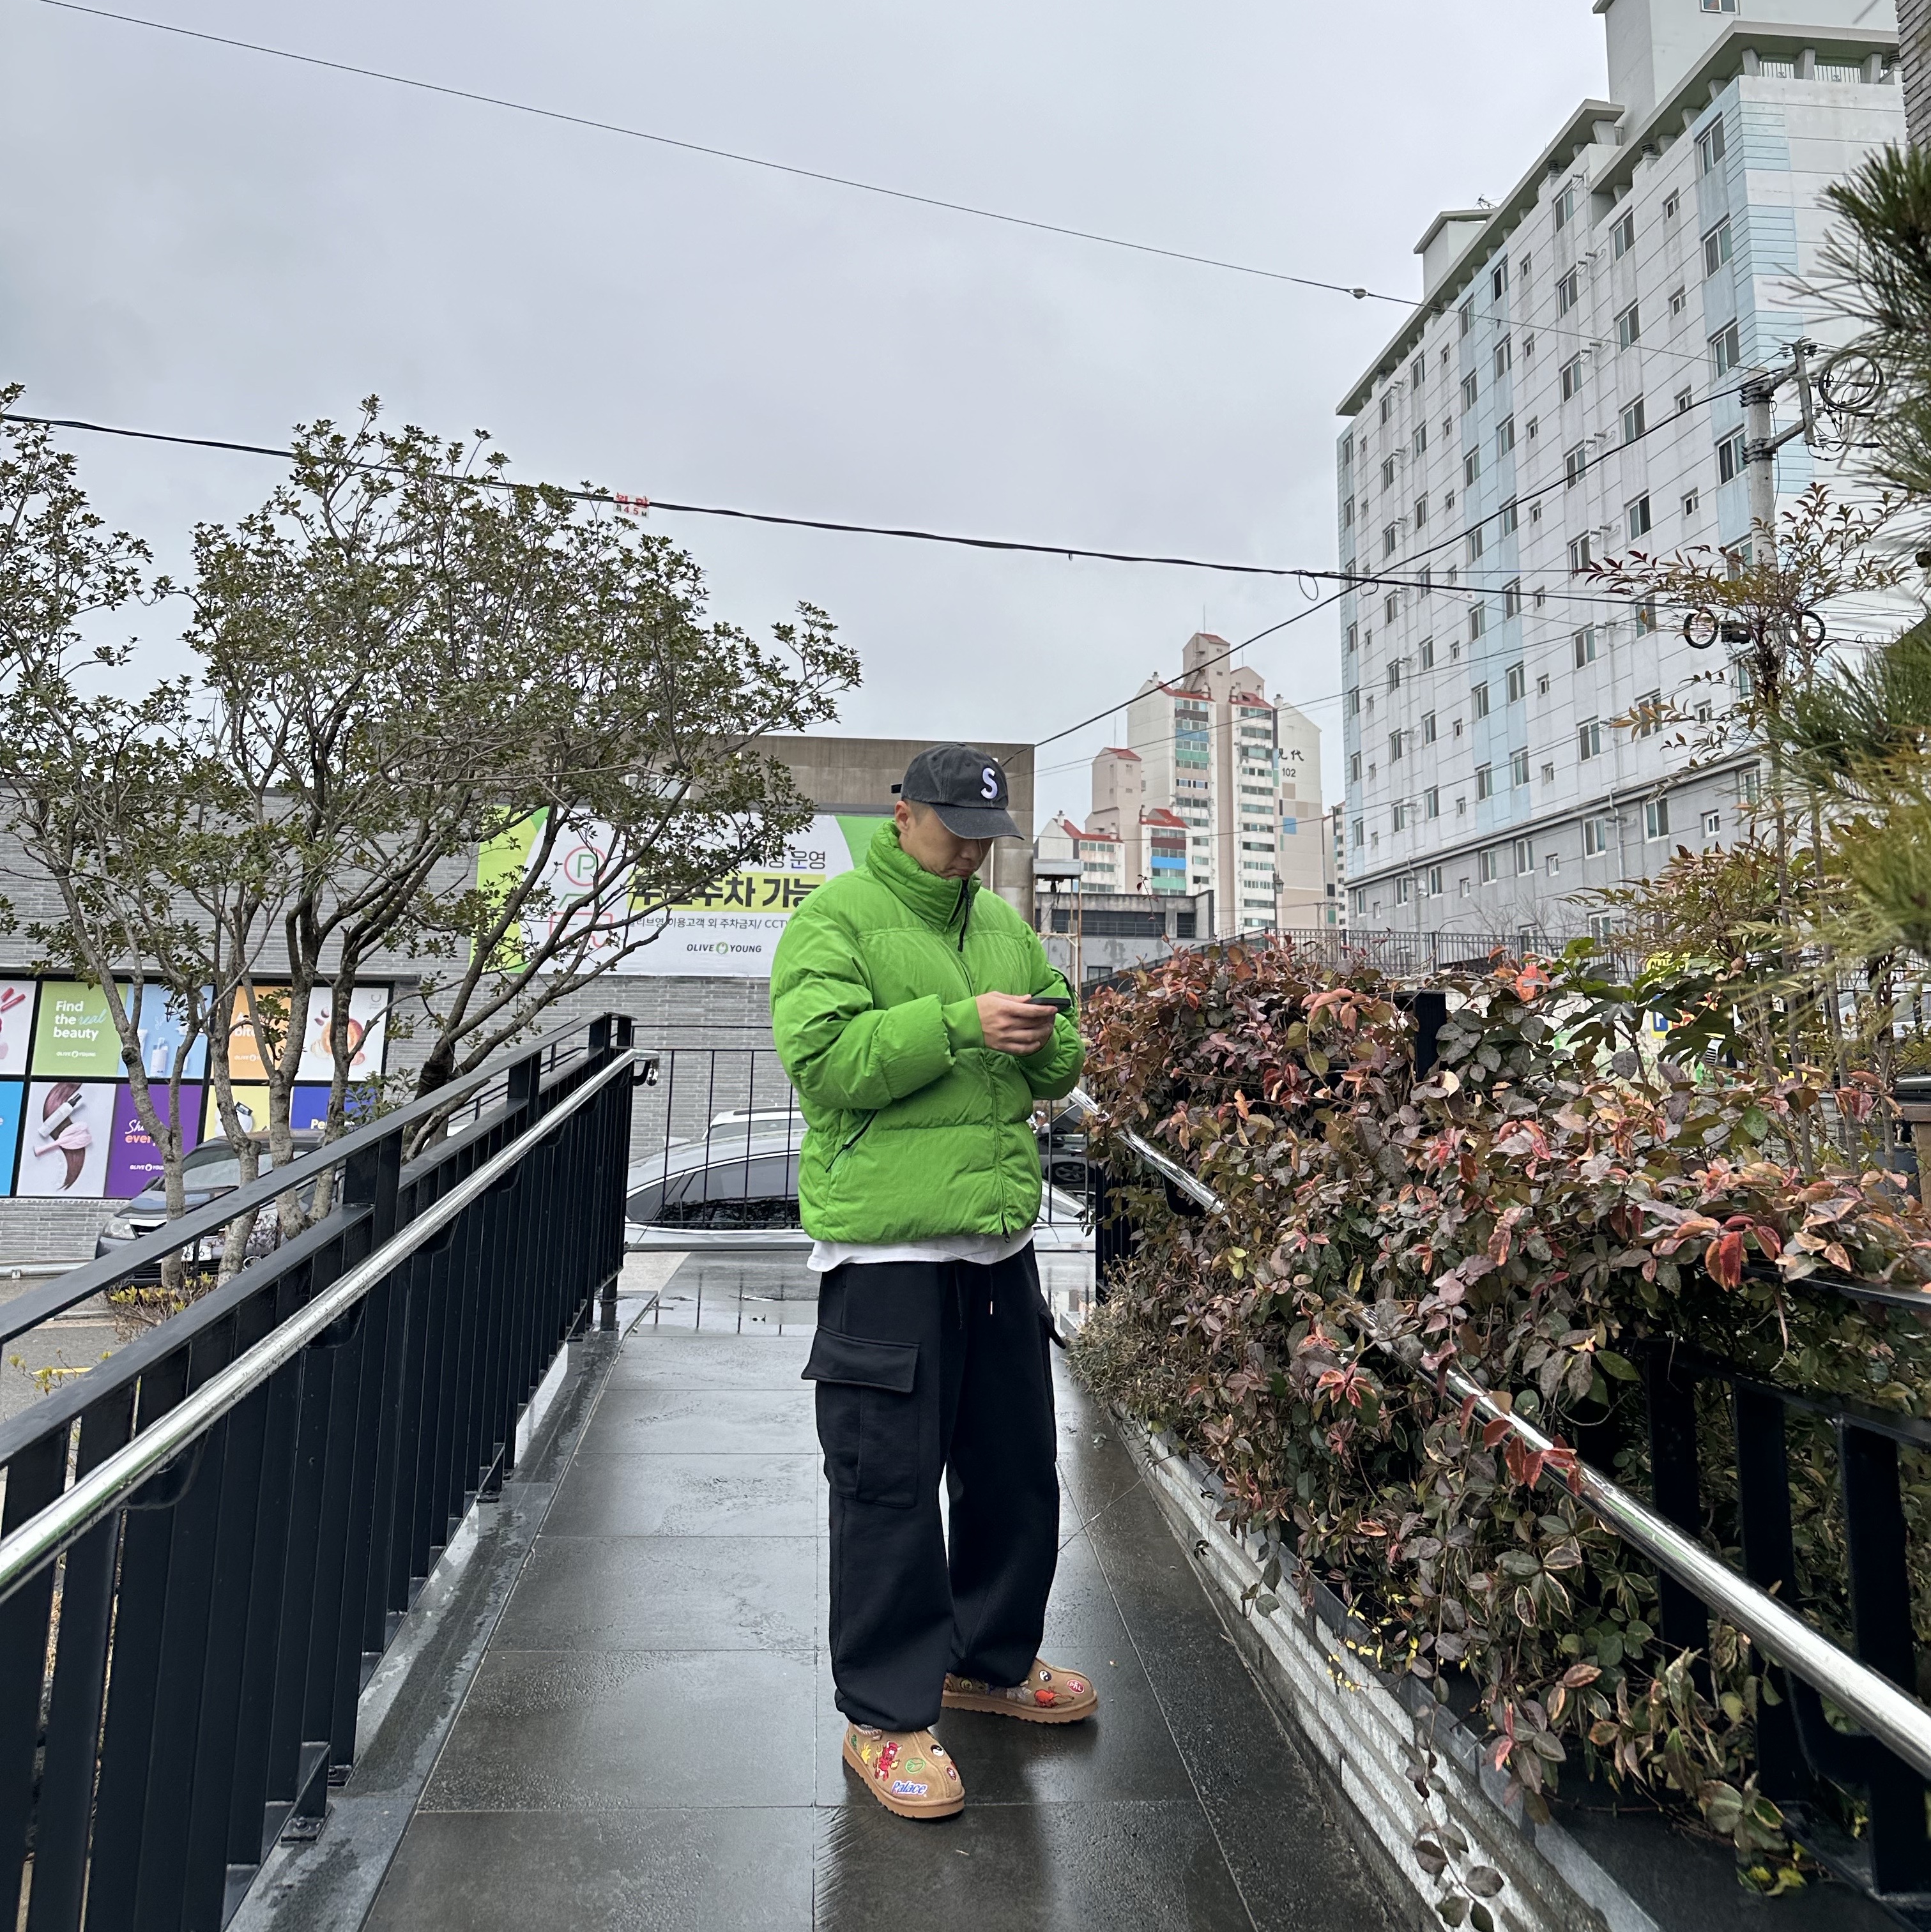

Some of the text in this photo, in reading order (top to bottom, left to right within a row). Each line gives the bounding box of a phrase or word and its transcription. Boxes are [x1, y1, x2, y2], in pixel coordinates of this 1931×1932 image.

[1282, 768, 1296, 778] 102
[981, 767, 998, 800] S
[790, 850, 825, 869] 운영
[627, 917, 665, 928] 리브영
[687, 943, 762, 953] OLIVE YOUNG
[56, 1000, 84, 1012] Find
[54, 1008, 108, 1026] the real
[53, 1026, 99, 1042] beauty
[891, 1781, 927, 1795] Palace
